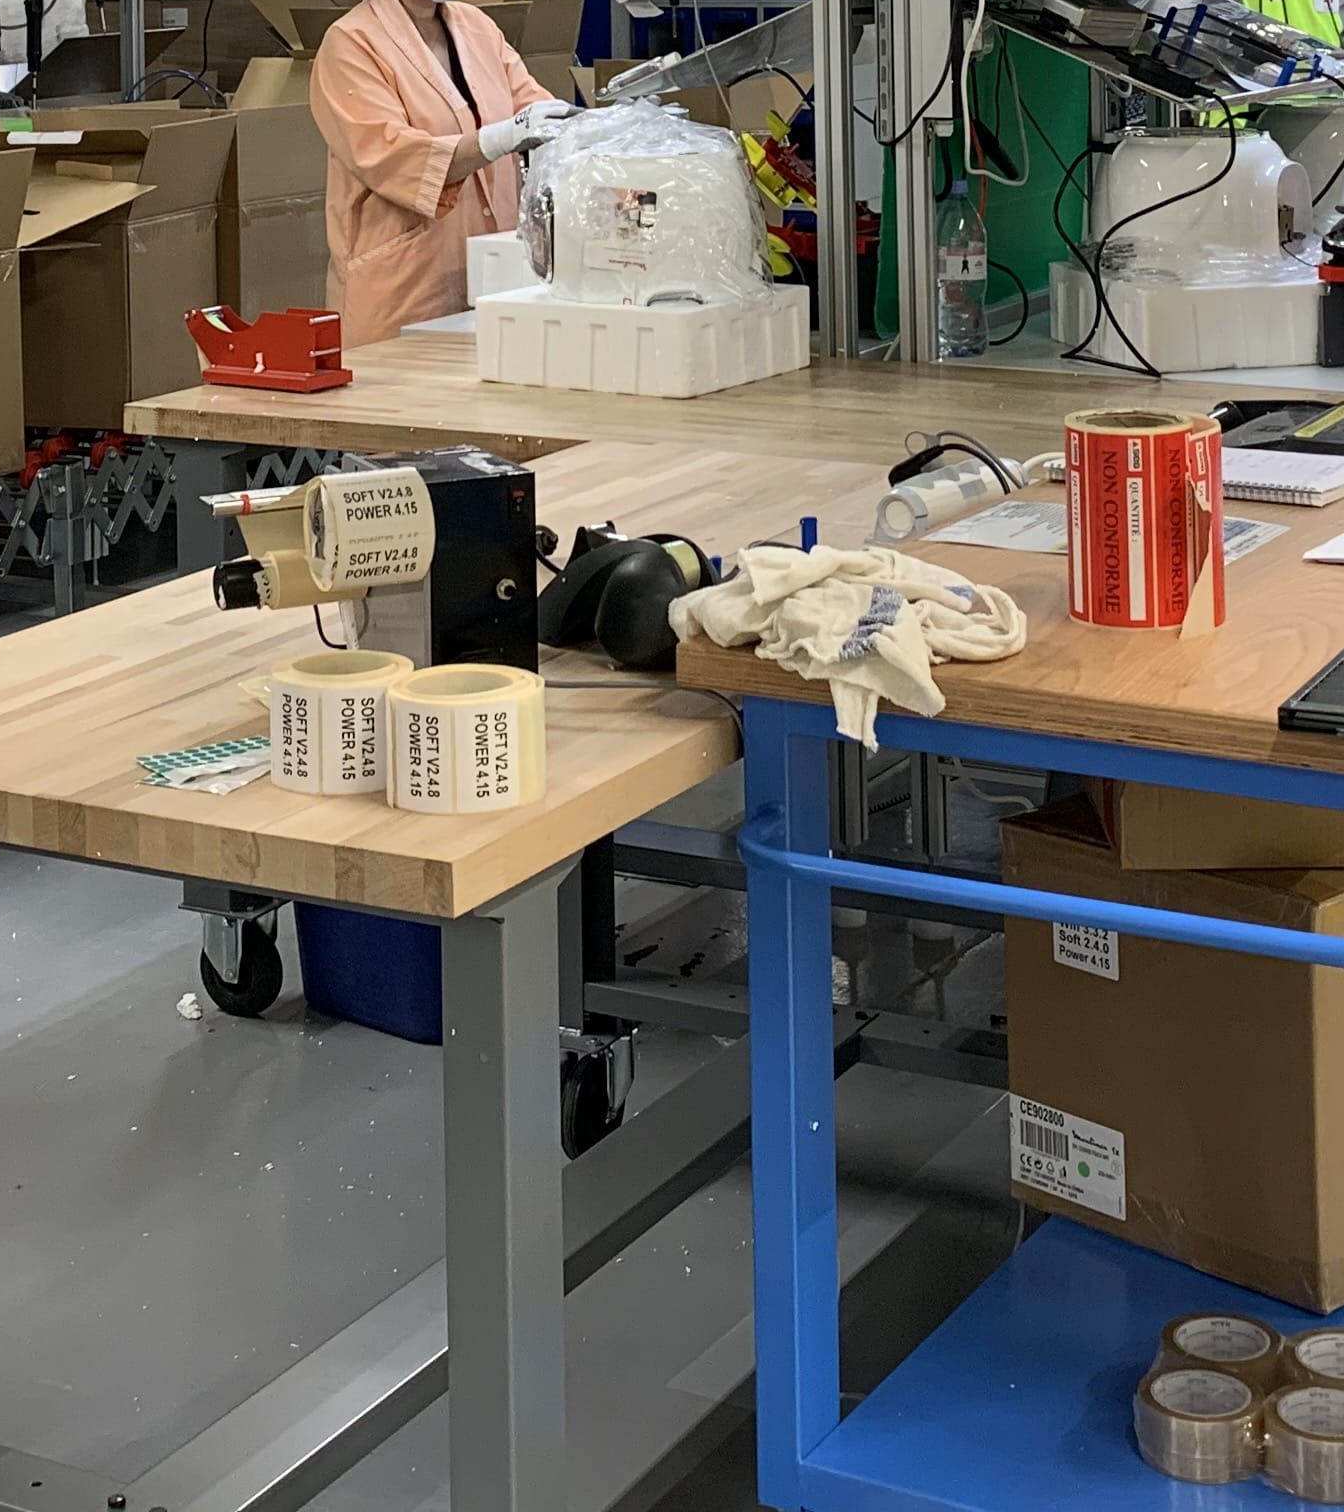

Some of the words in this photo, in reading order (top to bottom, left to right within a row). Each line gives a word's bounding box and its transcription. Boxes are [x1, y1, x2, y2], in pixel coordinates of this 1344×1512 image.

[1102, 450, 1118, 495] NON
[1168, 449, 1181, 489] NON
[343, 490, 375, 504] SOFT
[377, 486, 413, 500] V2.4.8
[346, 504, 392, 522] POWER
[394, 501, 418, 516] 4.15
[345, 565, 391, 579] POWER
[393, 562, 417, 573] 4.15
[349, 551, 381, 566] SOFT
[384, 547, 418, 561] V2.4.8
[1103, 497, 1121, 615] CONFORME
[1169, 497, 1185, 611] CONFORME
[282, 693, 293, 746] POWER
[296, 697, 308, 736] SOFT
[341, 698, 356, 750] POWER
[361, 697, 375, 734] SOFT
[494, 712, 508, 749] SOFT
[408, 712, 422, 767] POWER
[425, 716, 440, 754] SOFT
[474, 713, 489, 768] POWER
[283, 748, 293, 776] 4.15
[296, 738, 308, 778] V2.4.8
[342, 753, 356, 780] 4.15
[361, 736, 376, 777] V2.4.8
[495, 752, 509, 794] V2.4.8
[410, 769, 422, 798] 4.15
[426, 757, 441, 798] V2.4.8
[476, 770, 490, 799] 4.15
[1059, 929, 1081, 946] Soft
[1083, 937, 1109, 954] 2.4.0
[1059, 945, 1088, 963] Power
[1090, 955, 1110, 970] 4.15
[1020, 1100, 1064, 1127] CE902800
